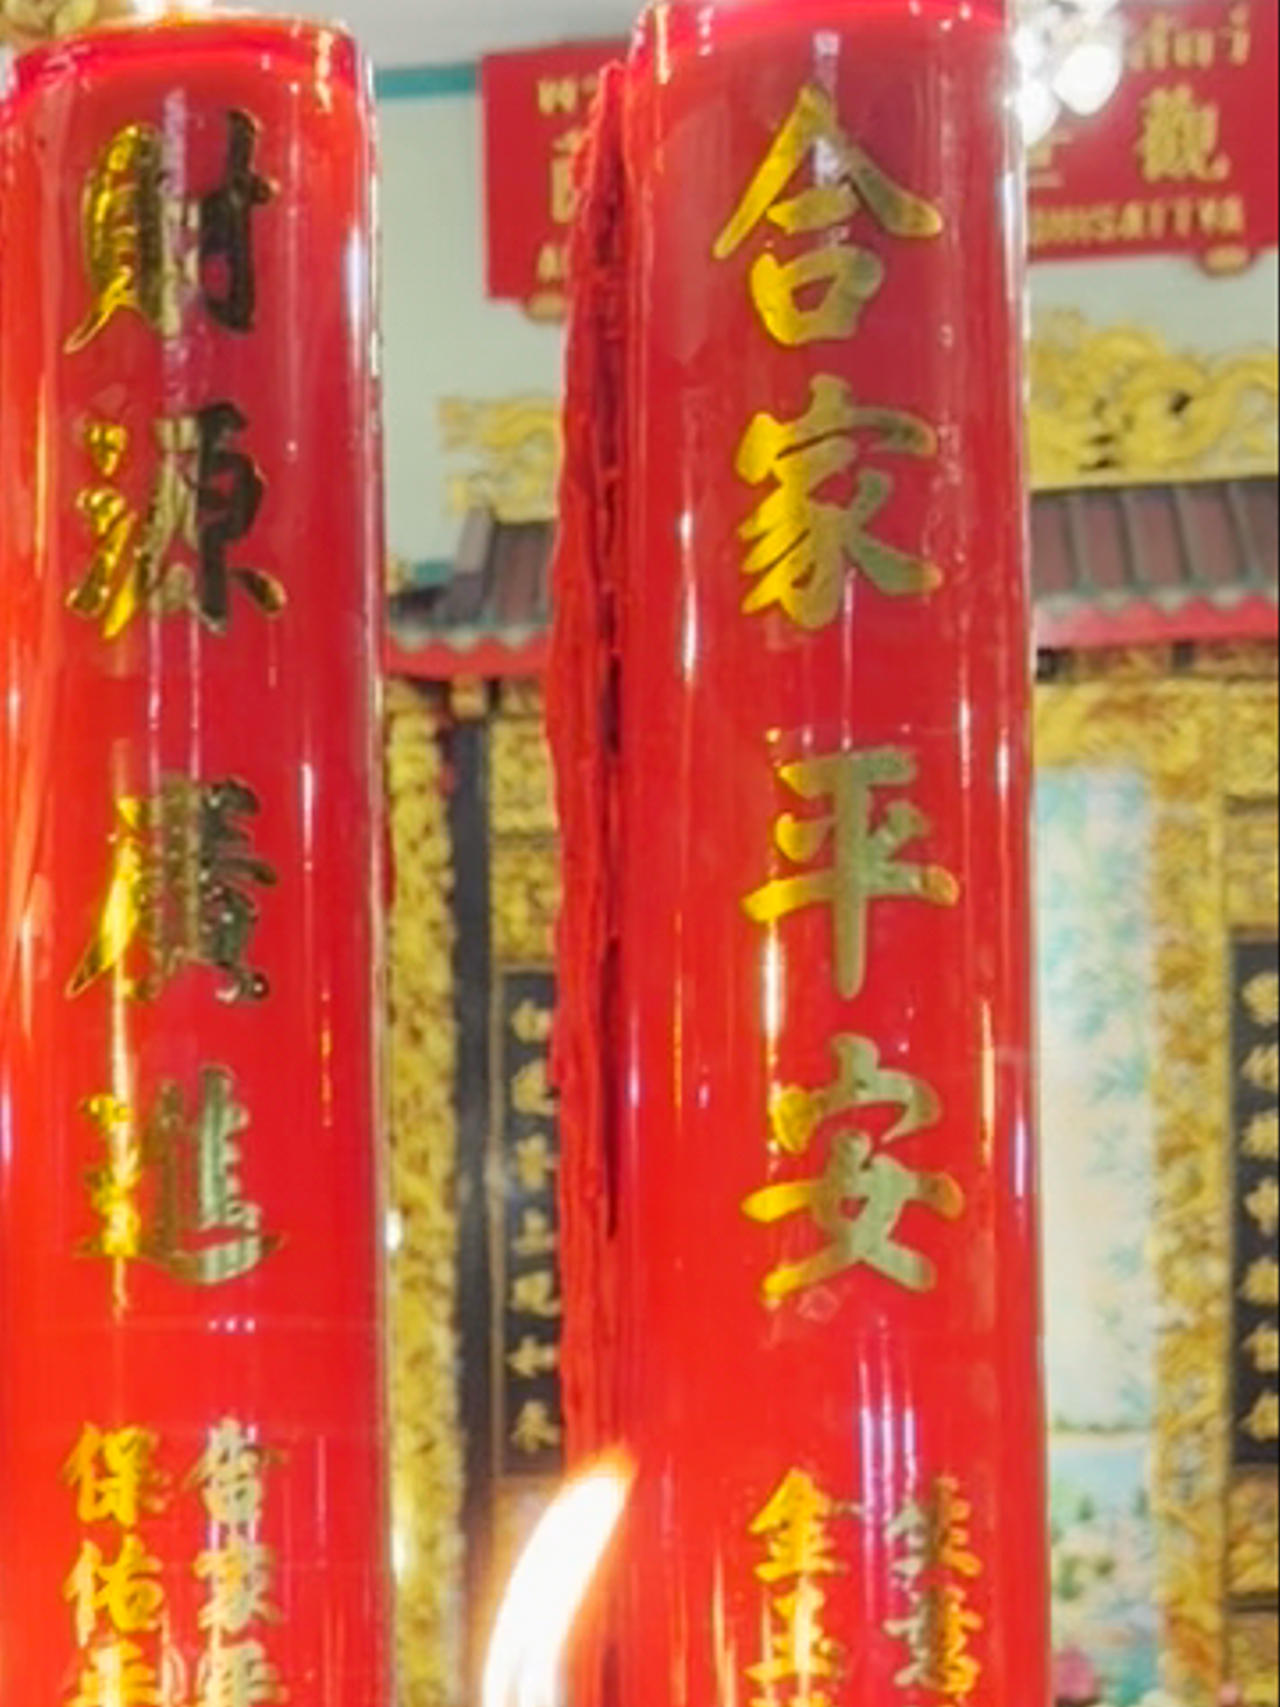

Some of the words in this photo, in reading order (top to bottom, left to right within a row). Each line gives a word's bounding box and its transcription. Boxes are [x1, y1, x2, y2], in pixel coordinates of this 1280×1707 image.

[62, 105, 290, 1289] 財源廣進
[711, 82, 966, 1303] 合家平安
